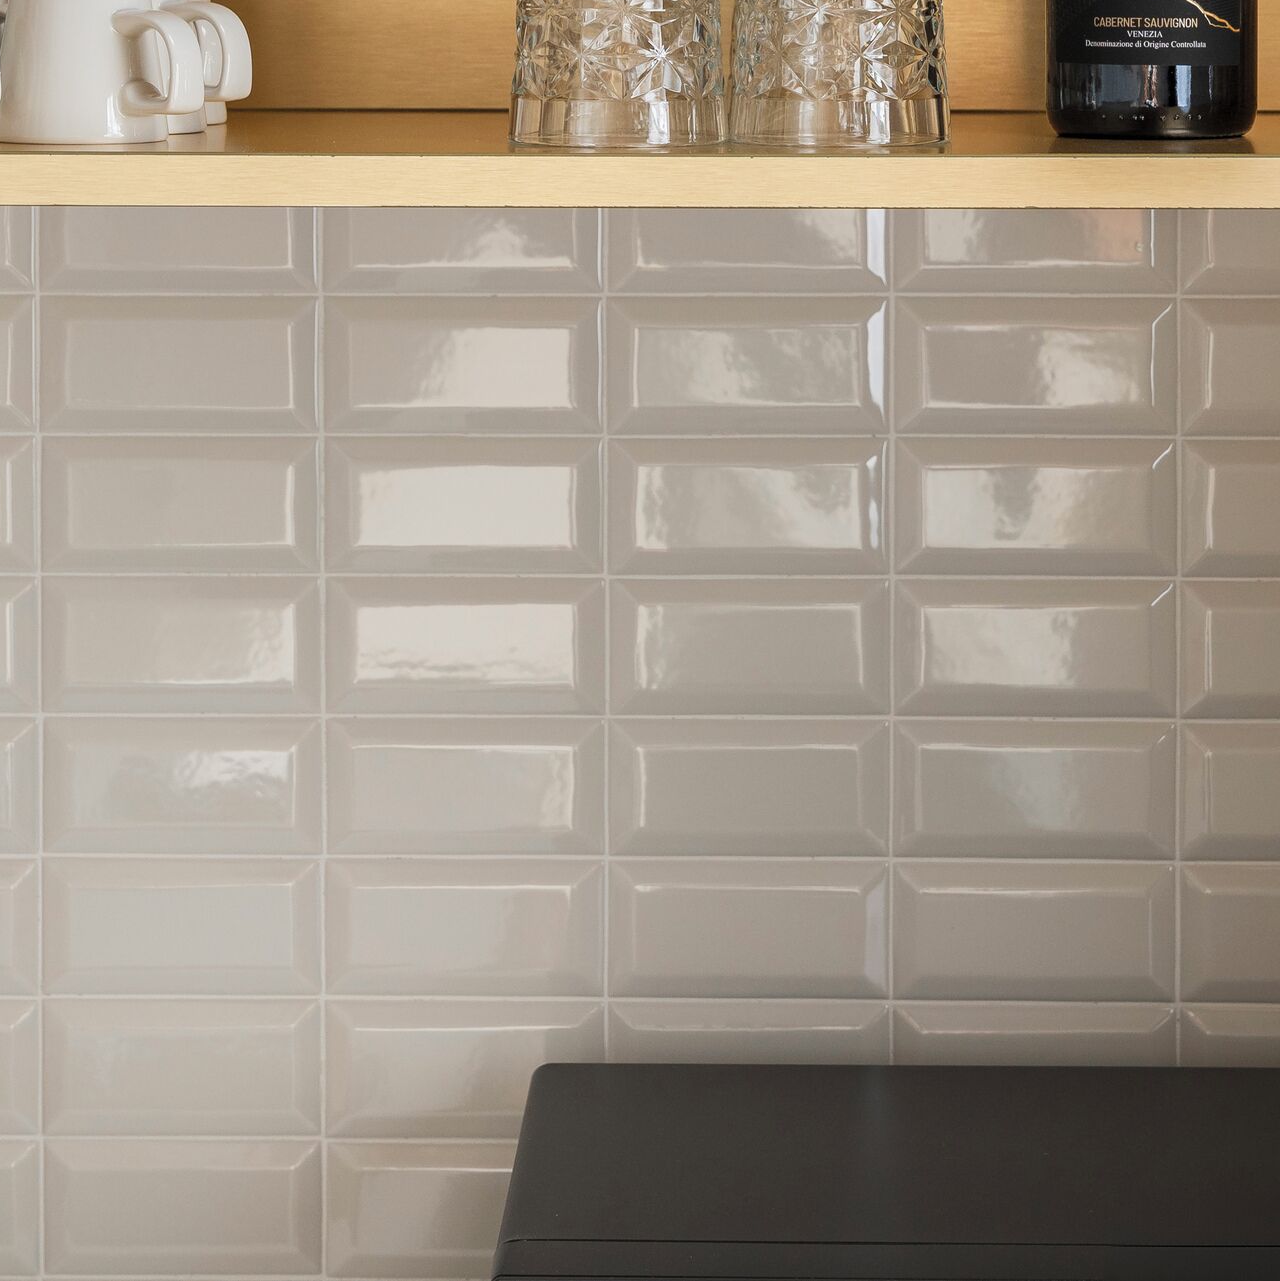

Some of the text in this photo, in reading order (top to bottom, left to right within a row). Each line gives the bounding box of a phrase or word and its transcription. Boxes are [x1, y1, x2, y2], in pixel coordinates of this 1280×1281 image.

[1093, 16, 1198, 28] CABERNET SAUVIGNON
[1126, 30, 1163, 38] VENEZIA
[1085, 39, 1206, 50] Denominazione di Origine Controllata
